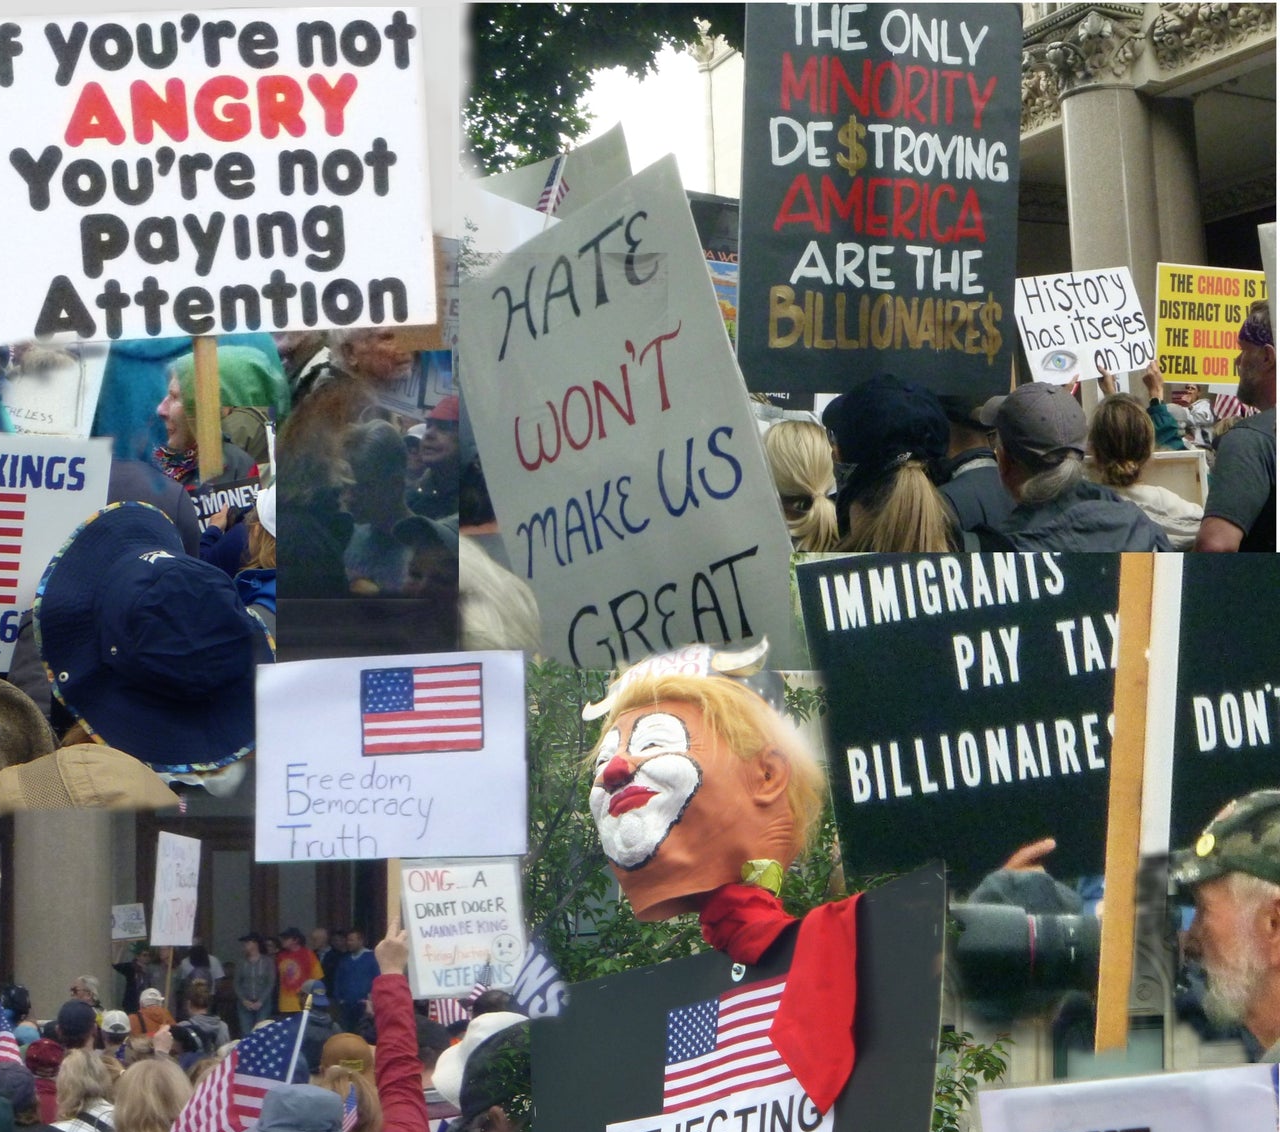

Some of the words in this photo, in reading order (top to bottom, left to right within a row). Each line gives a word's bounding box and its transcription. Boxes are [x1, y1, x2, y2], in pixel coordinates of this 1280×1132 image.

[44, 13, 280, 86] you're
[296, 11, 417, 69] not
[793, 3, 868, 51] THE
[880, 10, 988, 66] ONLY
[64, 73, 357, 147] ANGRY
[780, 53, 997, 130] MINORITY
[9, 145, 256, 211] You're
[279, 137, 397, 196] not
[773, 173, 986, 243] AMERICA
[492, 211, 658, 362] HATE
[790, 241, 893, 289] ARE
[907, 246, 984, 294] THE
[1170, 274, 1193, 293] THE
[1197, 275, 1240, 296] CHAOS
[1244, 279, 1256, 298] IS
[35, 269, 408, 340] Attention
[1021, 315, 1065, 350] has
[1160, 300, 1220, 321] DISTRACT
[1225, 306, 1241, 323] US
[1159, 355, 1197, 375] STEAL
[1203, 357, 1228, 375] OUR
[1166, 328, 1188, 347] THE
[517, 476, 650, 579] MAKE
[658, 426, 743, 517] US
[819, 552, 1065, 632] IMMIGRANTS
[953, 627, 1021, 691] PAY
[286, 760, 411, 793] Freedom
[276, 824, 377, 858] Truth
[287, 788, 433, 840] Democracy
[415, 900, 457, 919] DRAFT
